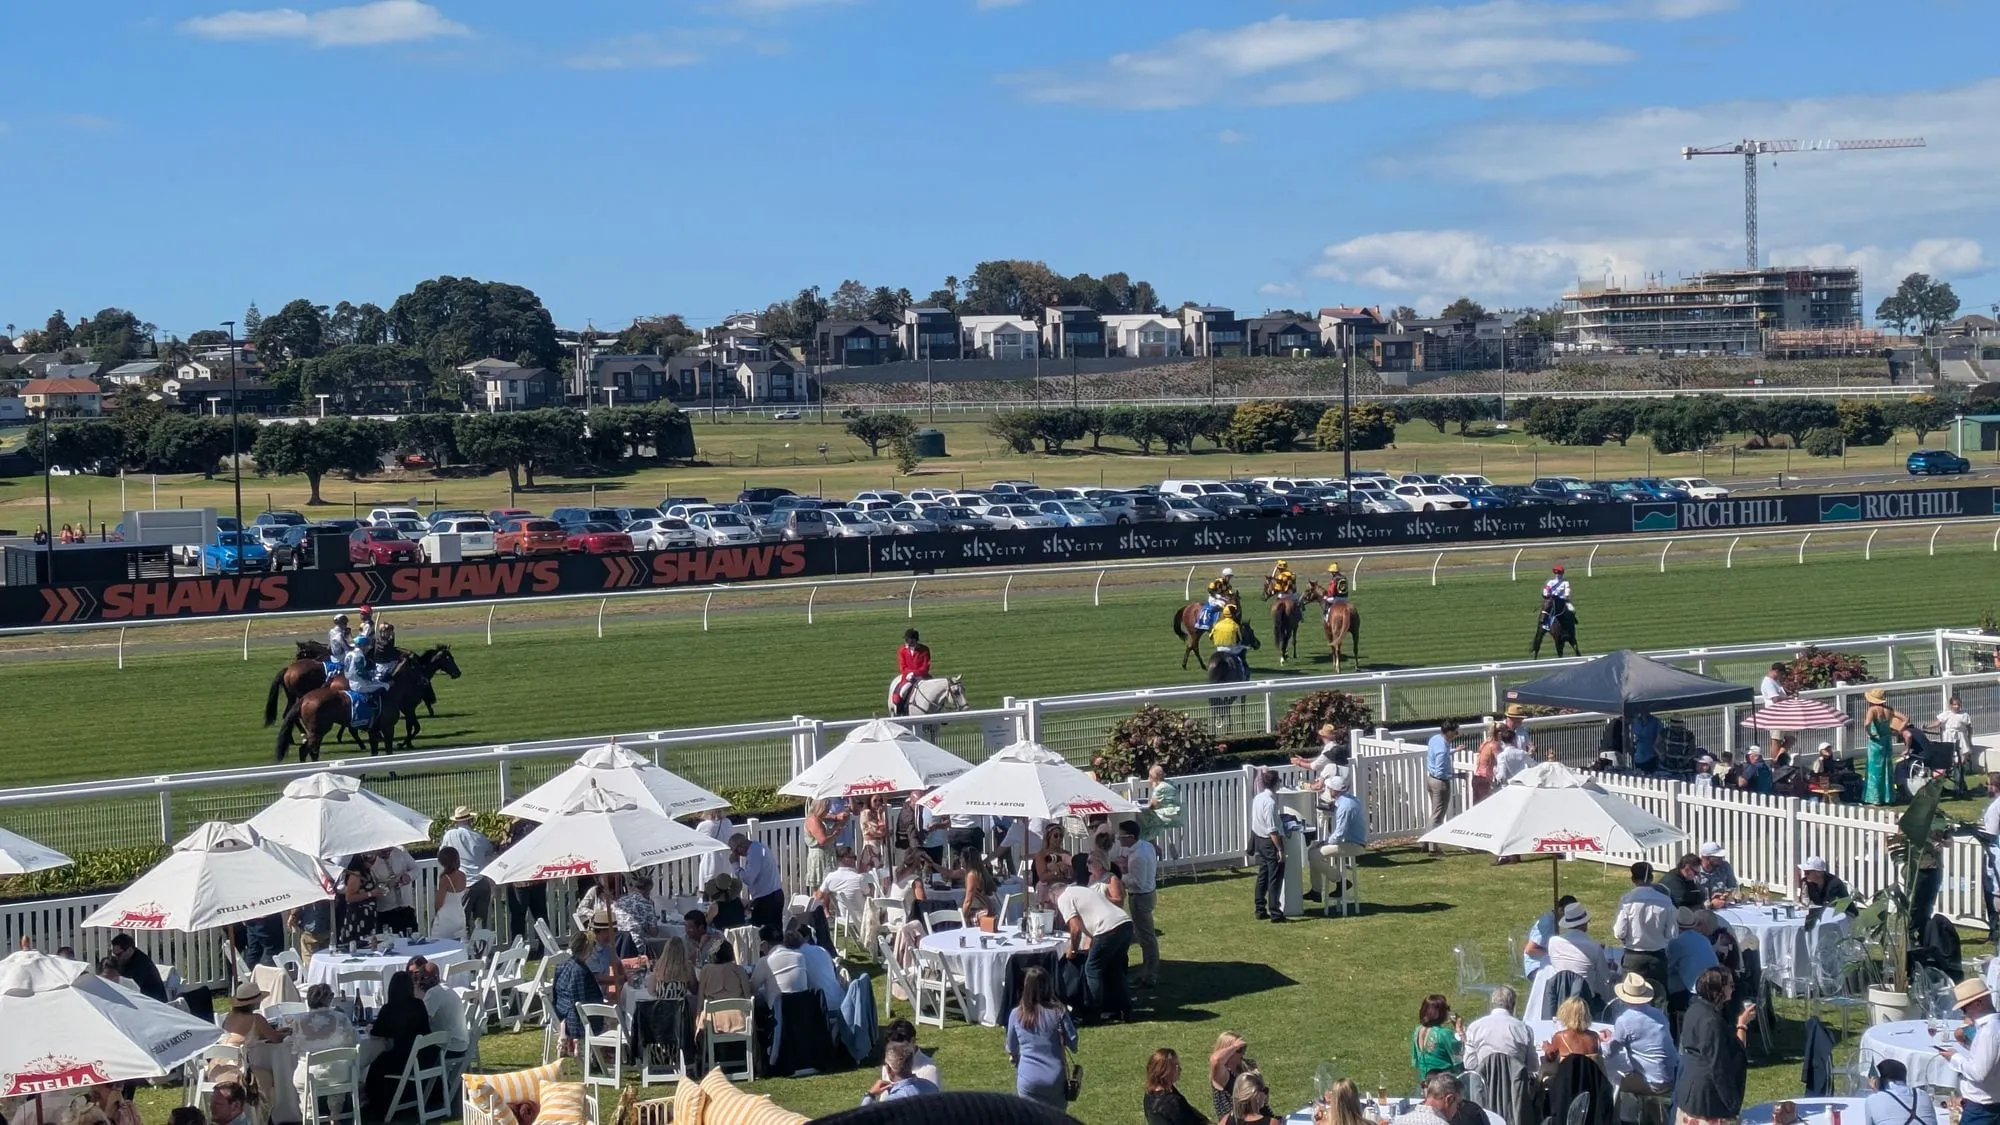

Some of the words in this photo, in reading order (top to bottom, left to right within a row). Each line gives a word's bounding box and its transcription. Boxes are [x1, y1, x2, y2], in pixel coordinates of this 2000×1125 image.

[1682, 501, 1734, 528] RICH
[1740, 499, 1787, 525] HILL
[1864, 493, 1915, 519] RICH
[1918, 491, 1964, 516] HILL
[653, 543, 806, 585] SHAW'S
[391, 559, 560, 601] SHAW'S
[102, 575, 290, 619] SHAW'S
[851, 786, 890, 796] STELLA
[1542, 843, 1594, 852] STELLA
[542, 867, 588, 879] STELLA
[217, 903, 248, 915] STELLA
[258, 893, 292, 906] ARTOIS
[121, 919, 160, 929] STELLA
[19, 1073, 96, 1093] STELLA
